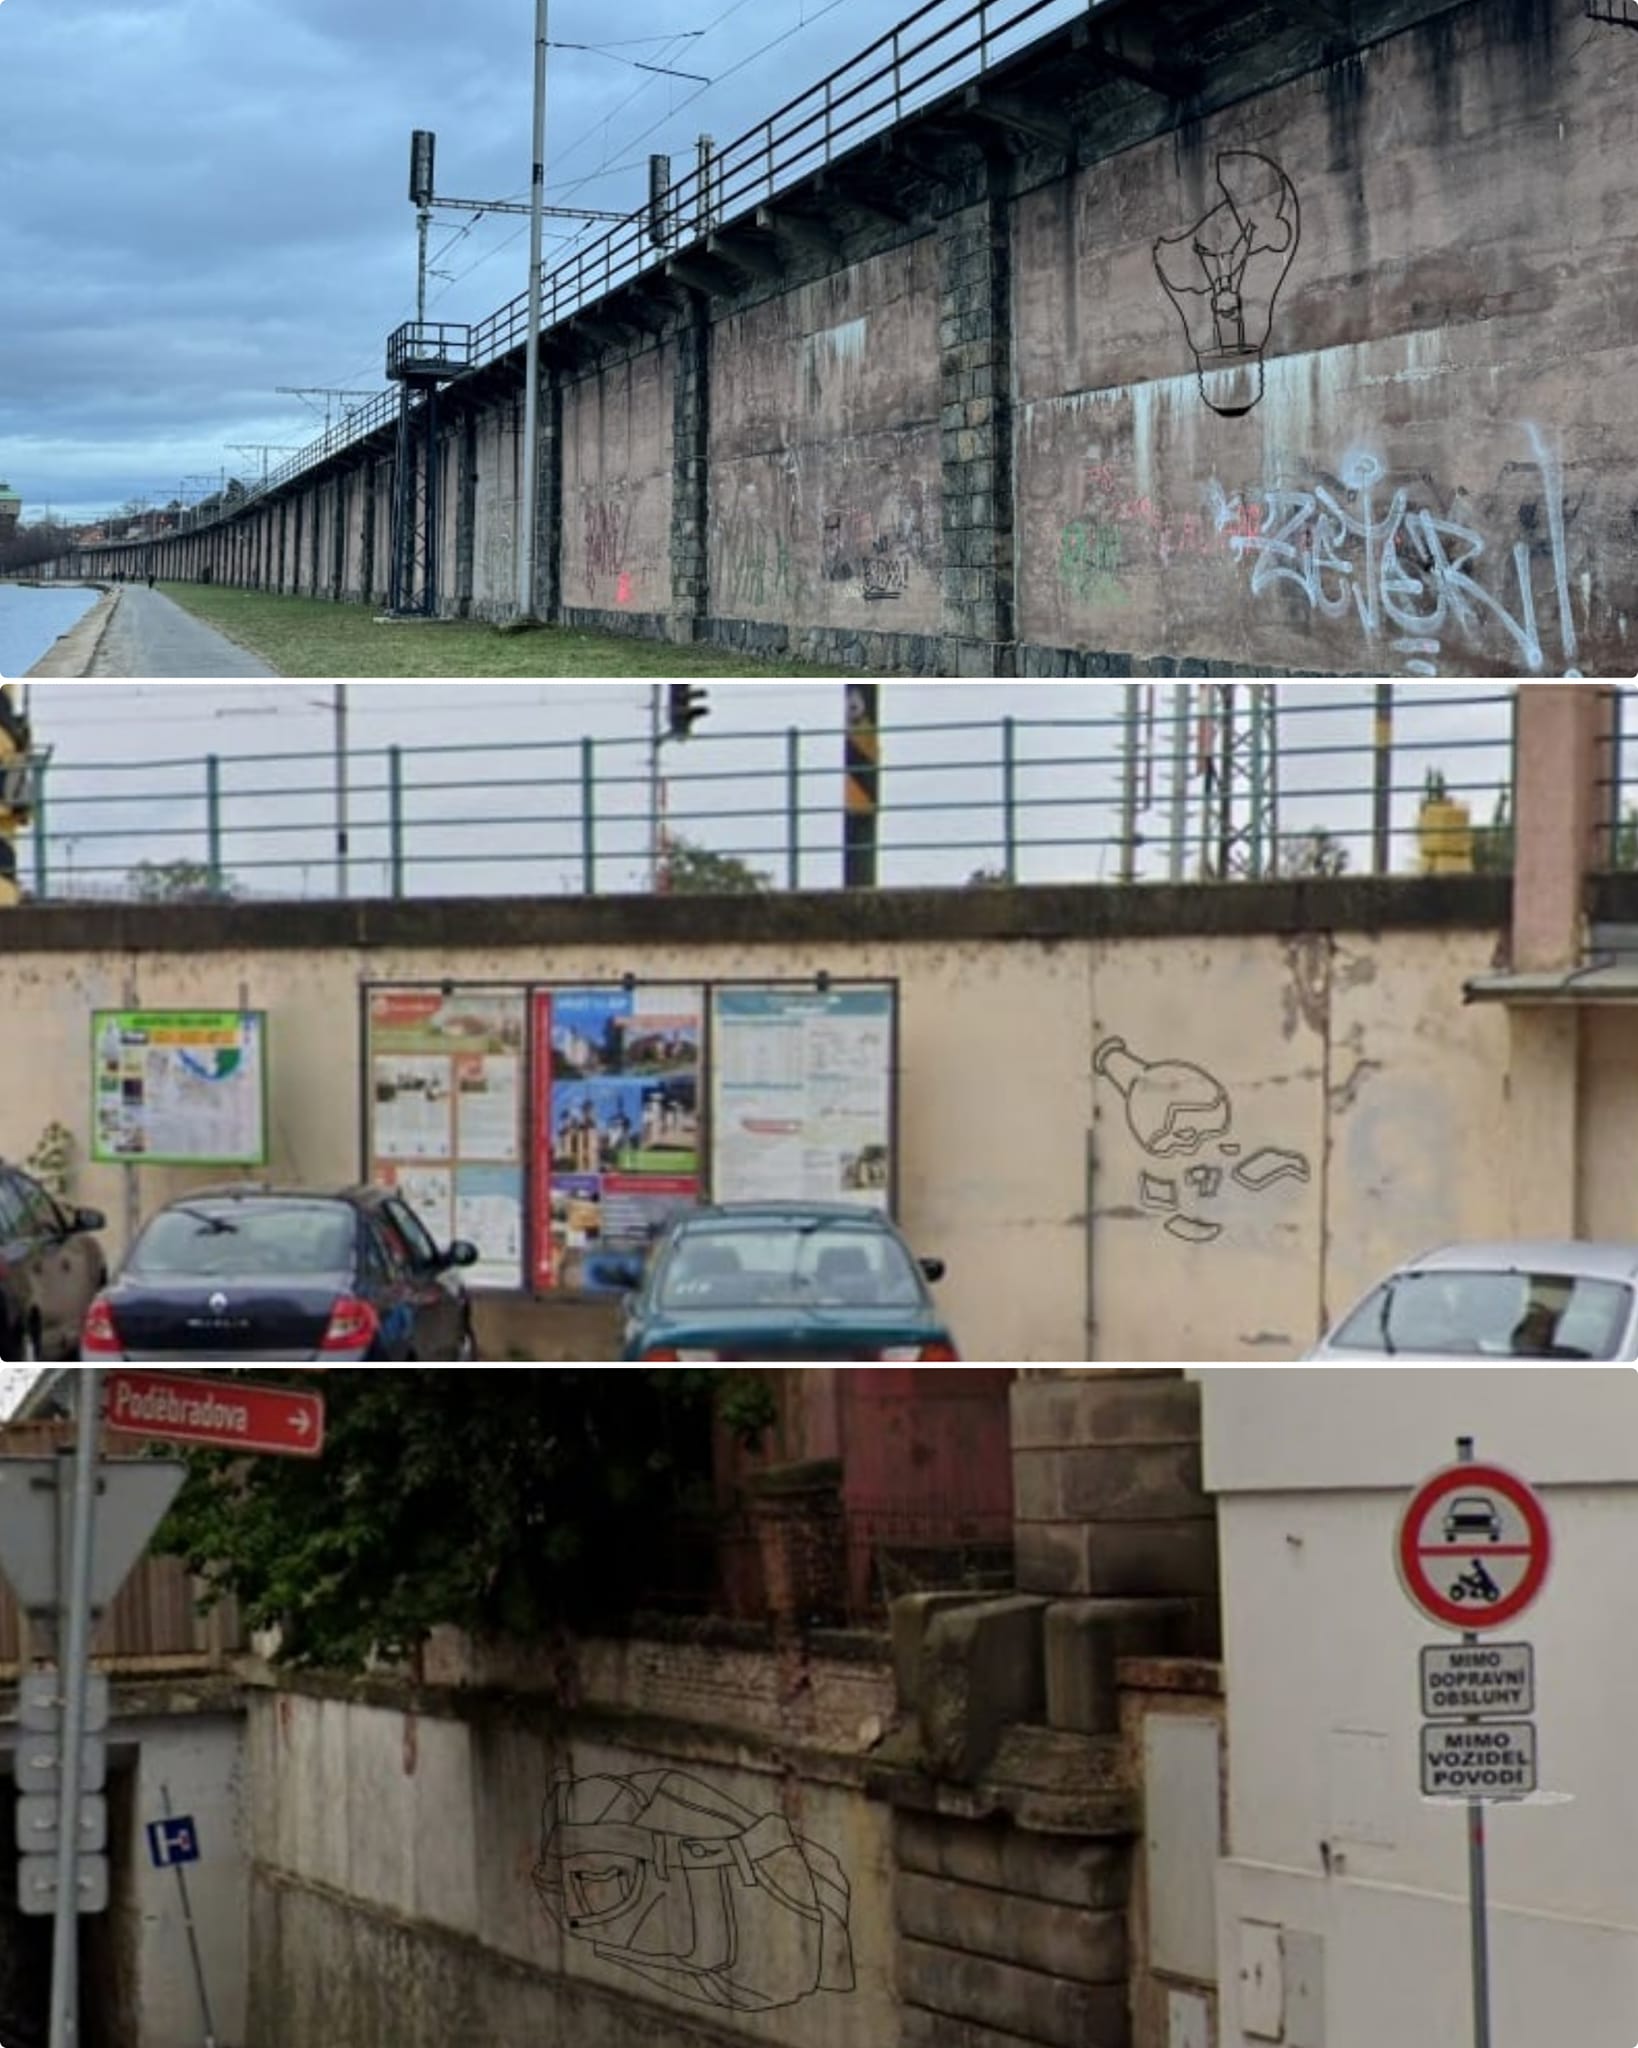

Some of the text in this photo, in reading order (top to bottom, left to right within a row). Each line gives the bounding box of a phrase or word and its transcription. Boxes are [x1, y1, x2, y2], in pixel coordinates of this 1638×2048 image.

[116, 1380, 248, 1431] Poděbradova
[1449, 1652, 1501, 1667] MIMO
[1432, 1688, 1522, 1706] OBSLUHY
[1445, 1732, 1511, 1749] MIMO
[1428, 1750, 1528, 1767] VOZIDEL
